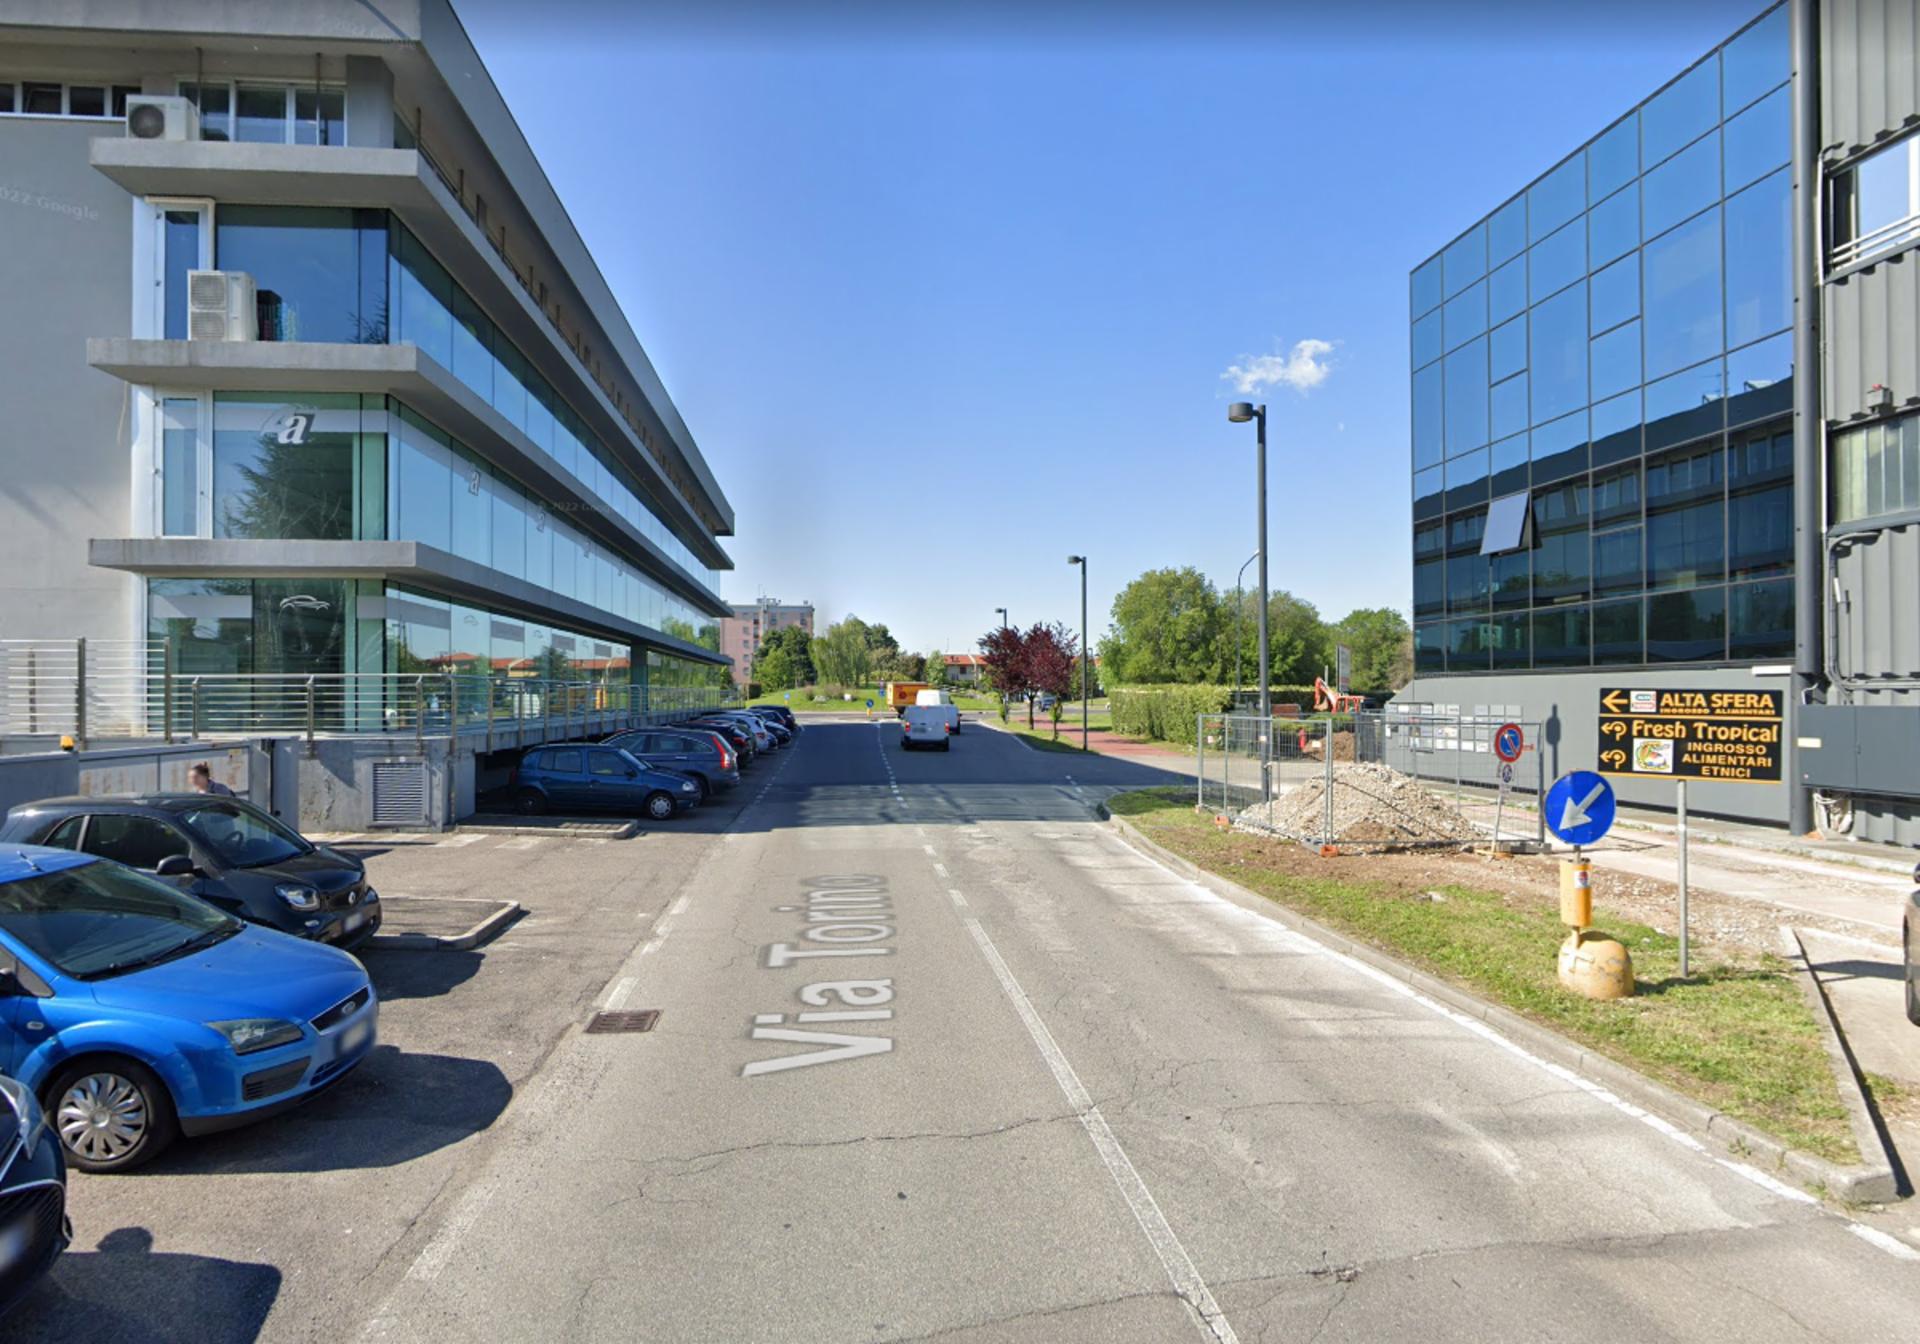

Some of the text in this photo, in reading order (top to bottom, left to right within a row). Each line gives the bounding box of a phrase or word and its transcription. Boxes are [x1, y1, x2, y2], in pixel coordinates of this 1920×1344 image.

[1661, 693, 1706, 707] ALTA
[1711, 693, 1774, 708] SFERA
[1714, 708, 1776, 716] ALIMENTARI
[1632, 719, 1778, 742] Fresh Tropical
[1687, 742, 1766, 754] INGROSSO
[1682, 754, 1772, 767] ALIMENTARI
[1701, 766, 1751, 778] ETNICI
